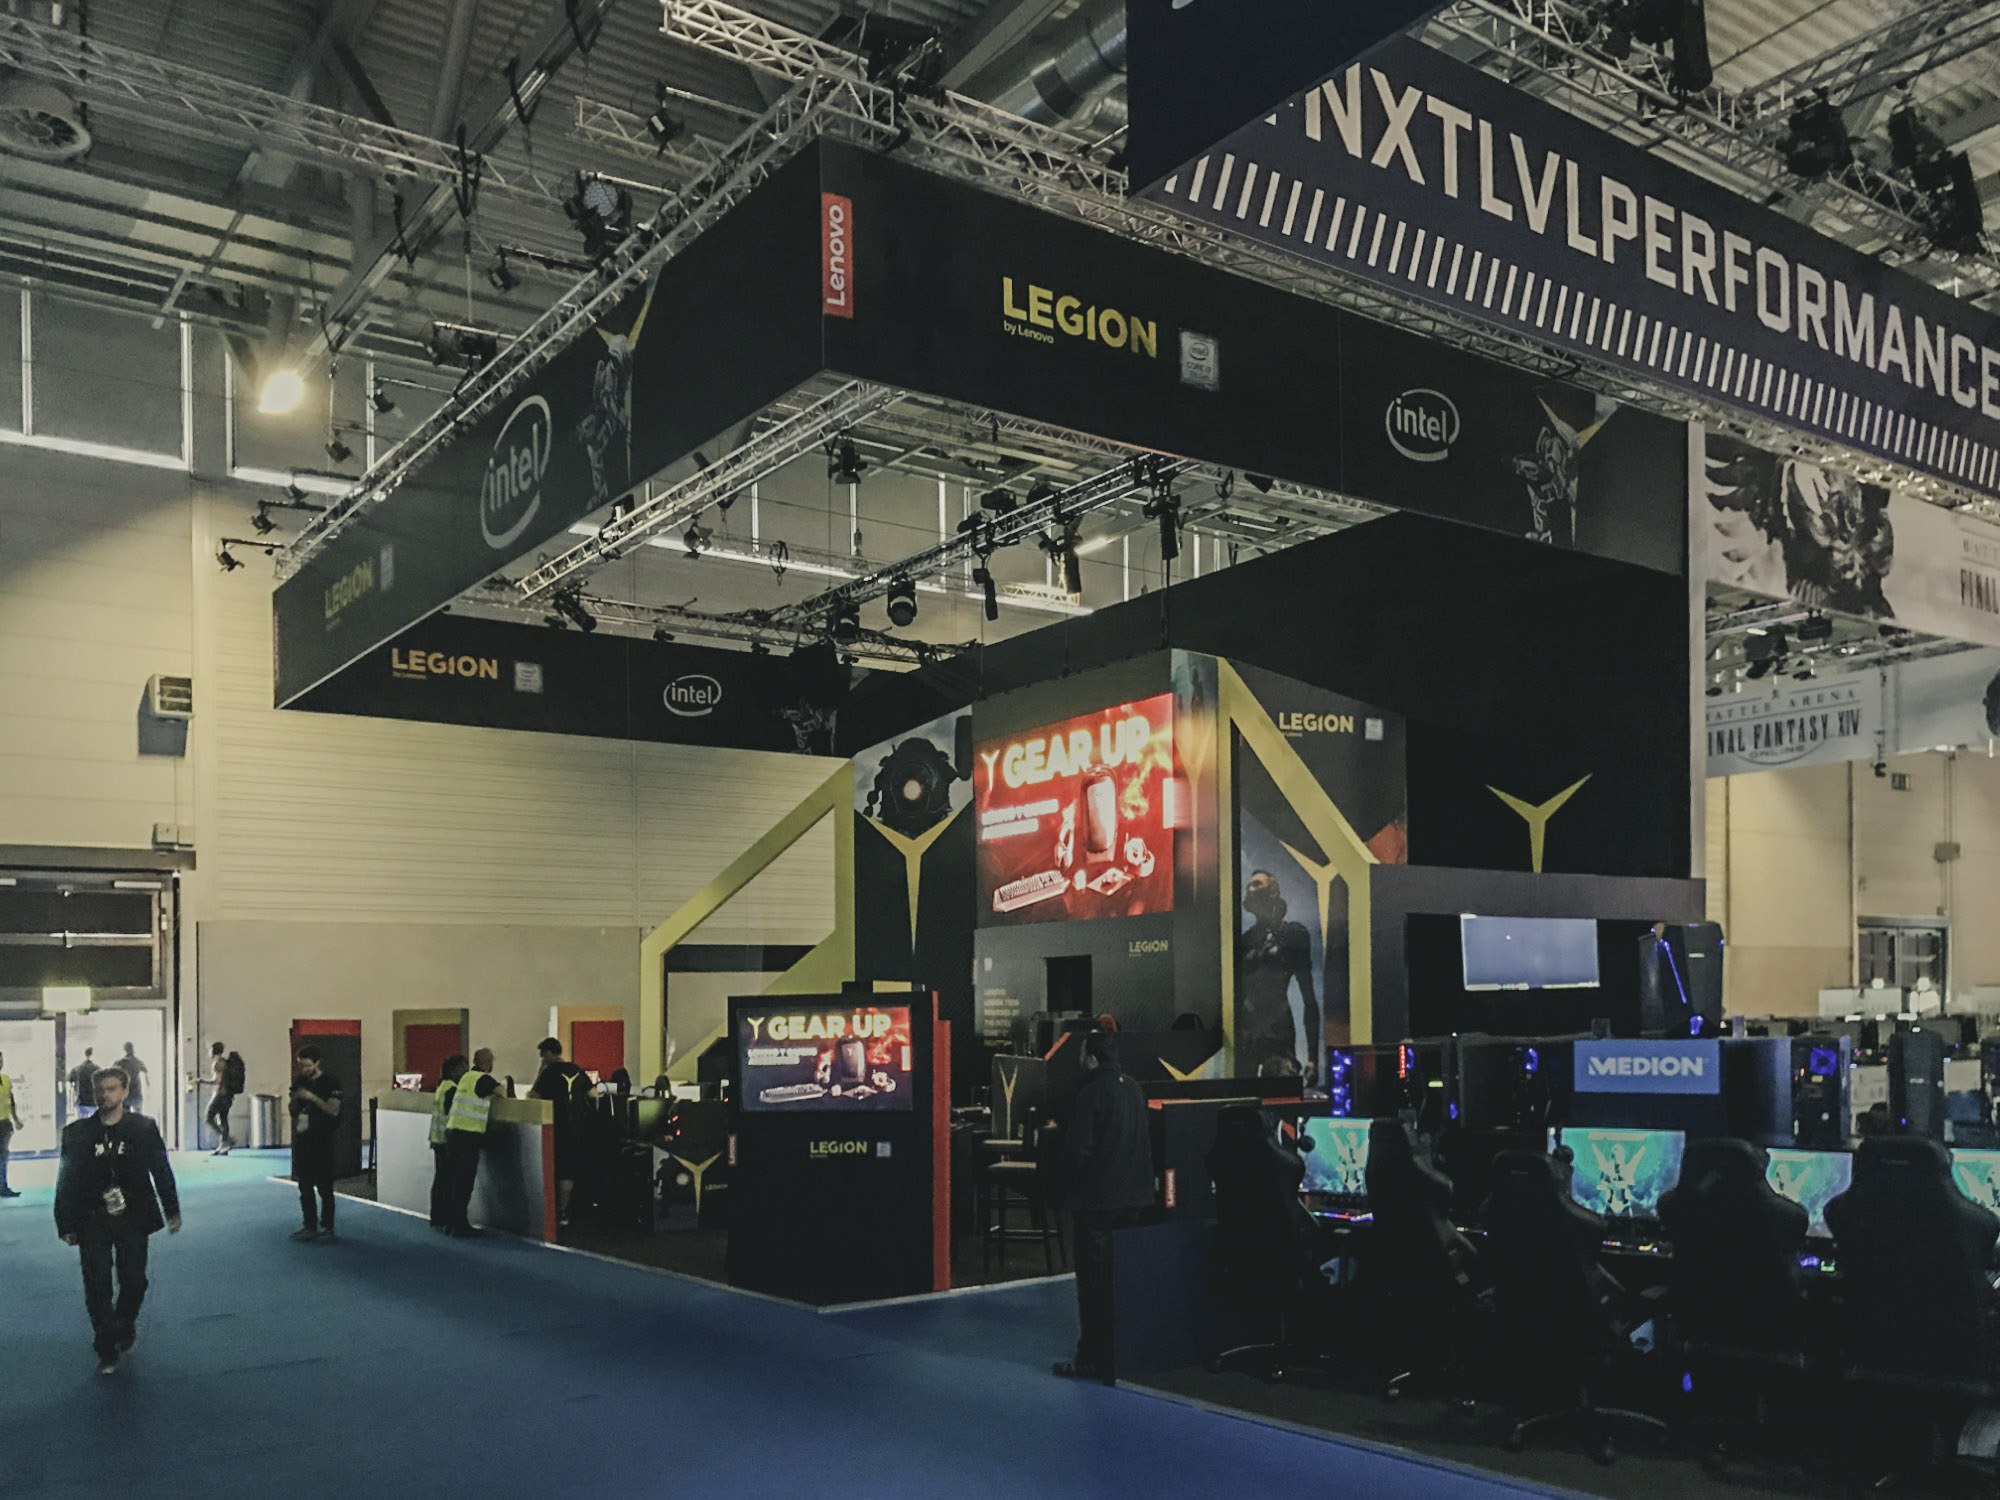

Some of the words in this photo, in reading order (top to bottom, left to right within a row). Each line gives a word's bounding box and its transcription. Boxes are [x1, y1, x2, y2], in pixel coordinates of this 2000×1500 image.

[827, 204, 845, 306] Lenovo
[1264, 62, 2000, 420] NXTLVLPERFORMANCE
[1003, 276, 1157, 357] LEGION
[1004, 320, 1017, 336] by
[1018, 325, 1054, 344] Lenovo
[1395, 397, 1447, 443] intel
[489, 422, 540, 512] intel
[325, 556, 373, 618] LEGION
[392, 648, 498, 680] LEGION
[671, 682, 713, 705] intel
[1789, 689, 1855, 708] ARENA
[1279, 712, 1354, 733] LEGION
[1706, 726, 1746, 757] INAL
[1753, 714, 1829, 750] FANTASY
[1838, 708, 1860, 737] XIV
[1003, 729, 1093, 789] GEAR
[1100, 716, 1150, 768] UP
[1129, 940, 1168, 953] LEGION
[768, 1015, 846, 1041] GEAR
[852, 1014, 892, 1039] UP
[1588, 1056, 1704, 1076] MEDION
[810, 1141, 867, 1154] LEGION
